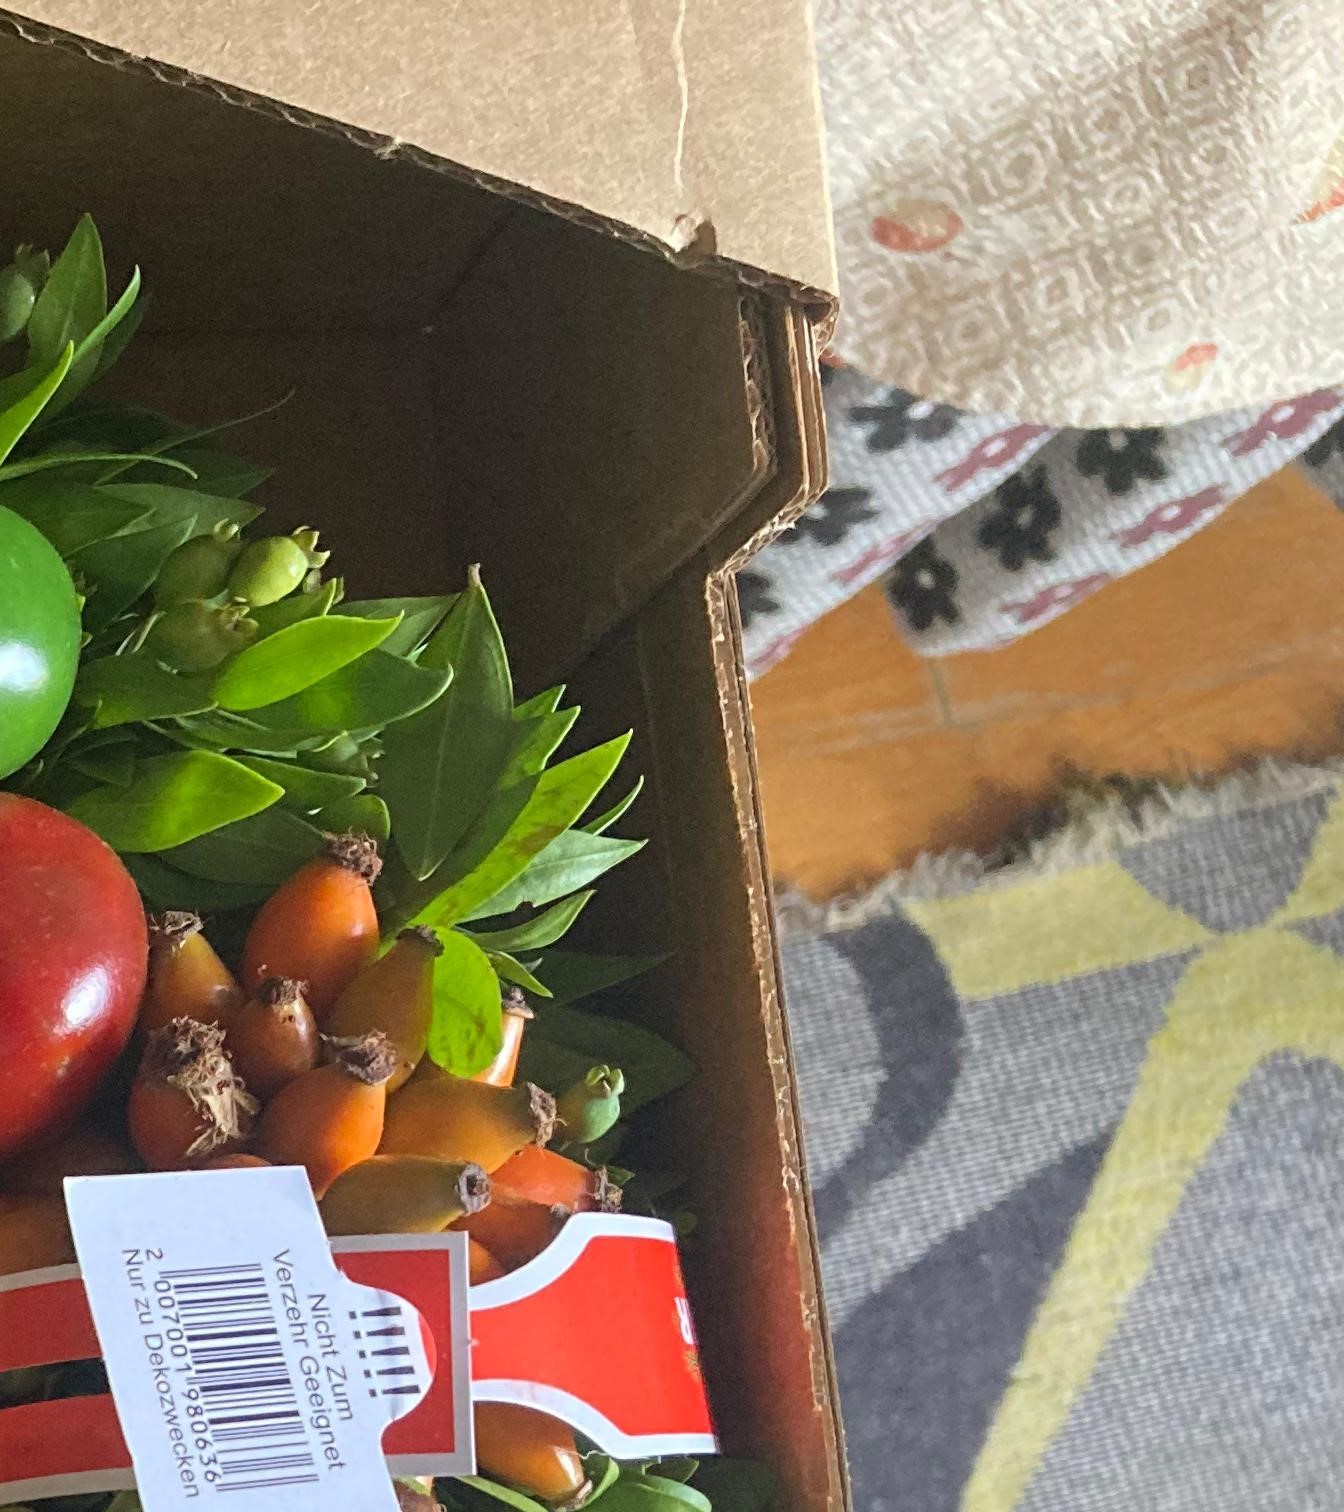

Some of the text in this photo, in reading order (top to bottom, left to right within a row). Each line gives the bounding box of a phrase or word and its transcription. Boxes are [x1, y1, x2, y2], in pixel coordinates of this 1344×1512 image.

[122, 1248, 200, 1498] Nur zu Dekozwecken
[145, 1248, 221, 1483] 2 007001 980636
[273, 1248, 346, 1471] Verzehr Geeignet
[307, 1293, 354, 1422] Nicht Zum
